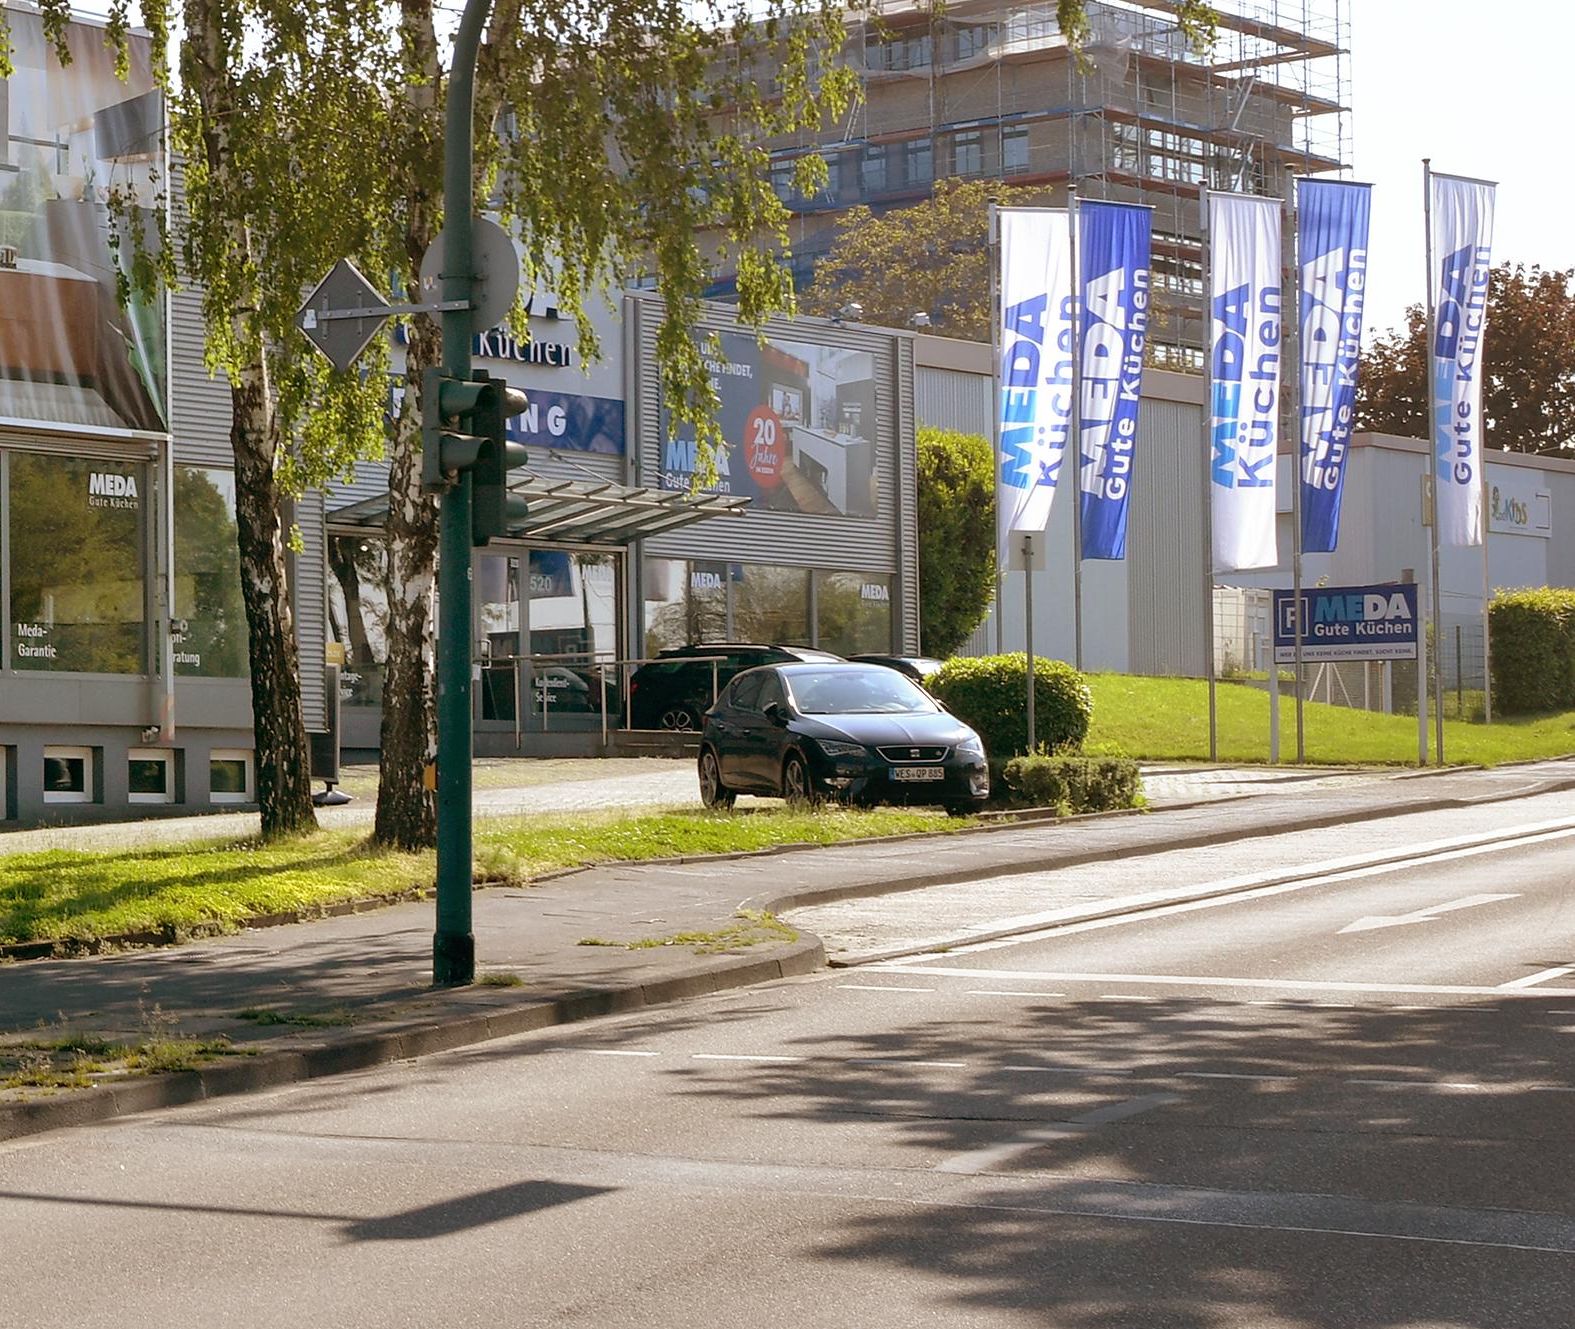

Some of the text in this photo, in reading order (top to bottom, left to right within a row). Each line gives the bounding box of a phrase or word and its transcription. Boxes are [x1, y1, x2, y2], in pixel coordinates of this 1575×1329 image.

[479, 328, 572, 367] Küchen
[1435, 244, 1472, 483] MEDA
[1454, 246, 1491, 485] Gute Küchen
[1081, 267, 1125, 499] MEDA
[1105, 269, 1149, 500] Gute Küchen
[1212, 283, 1249, 489] MEDA
[1302, 247, 1343, 489] MEDA
[1324, 248, 1366, 490] Gute Küchen
[1001, 293, 1047, 490] MEDA
[1037, 295, 1081, 488] Küchen
[1237, 286, 1279, 488] Küchen
[753, 418, 776, 445] 20
[666, 440, 730, 476] MEA
[89, 473, 138, 498] MEDA
[89, 496, 139, 509] Gute Küchen
[529, 576, 552, 592] 520
[691, 572, 722, 589] MEDA
[861, 584, 890, 601] MEDA
[1314, 593, 1411, 622] MEDA
[18, 623, 48, 638] Meda-
[1314, 622, 1412, 636] Gute Küchen
[18, 644, 57, 659] Garantie
[172, 652, 201, 667] ratung
